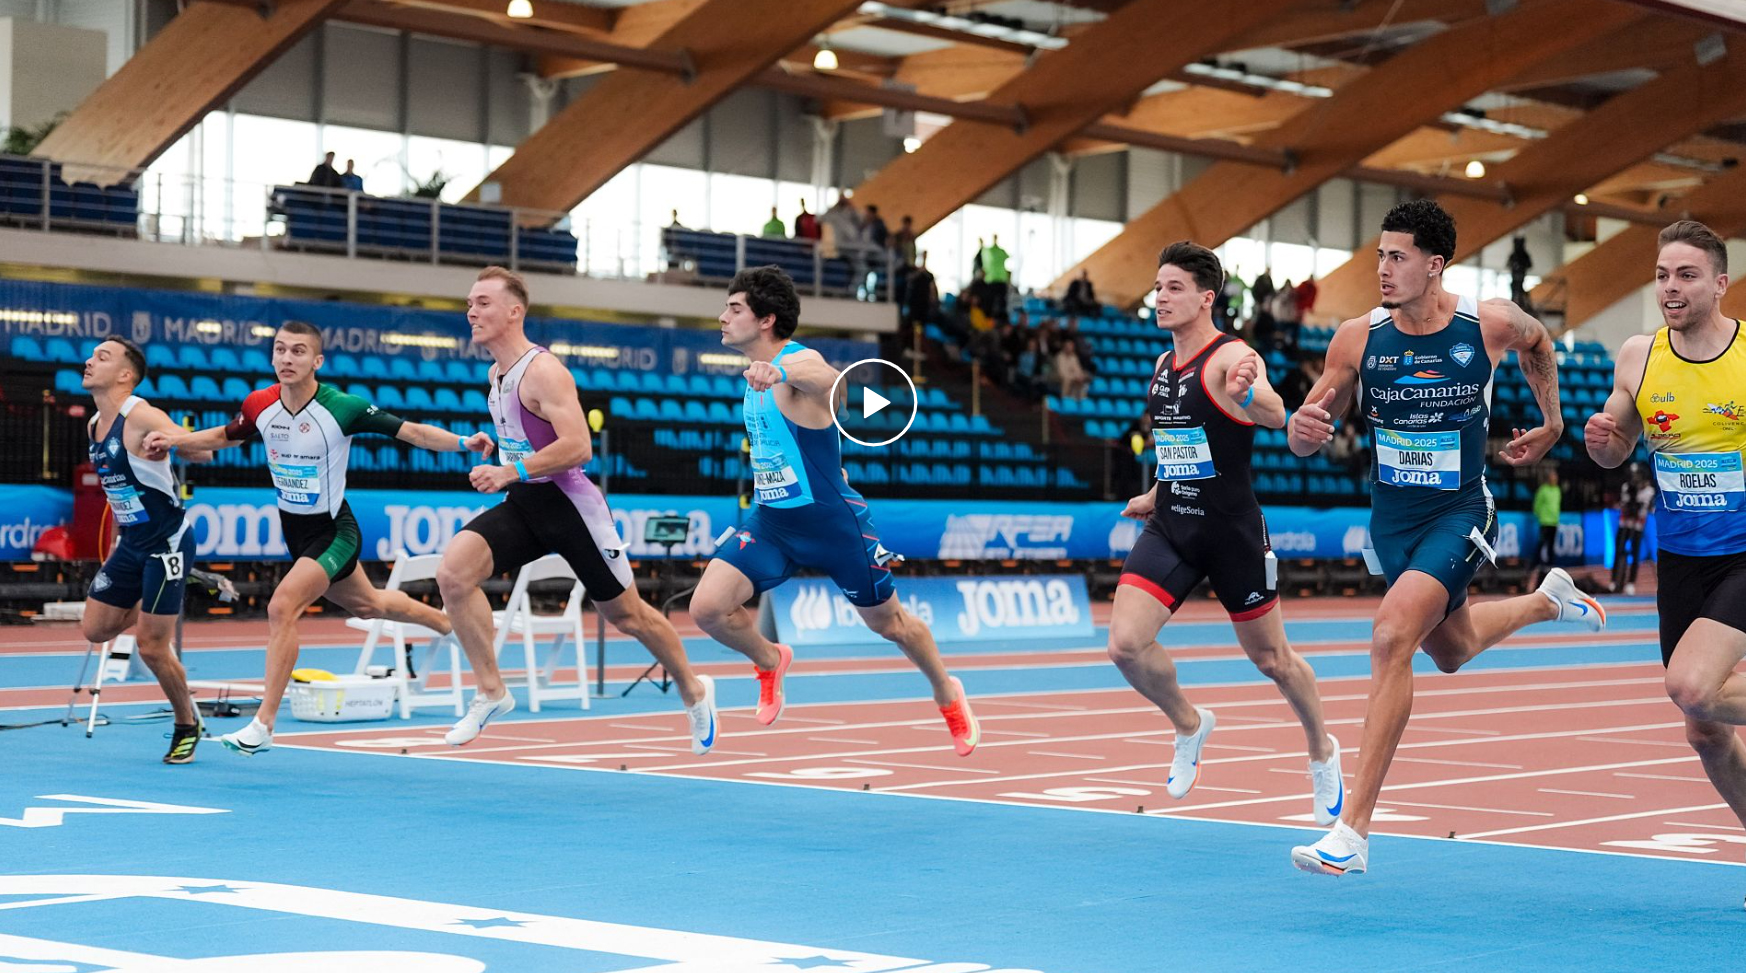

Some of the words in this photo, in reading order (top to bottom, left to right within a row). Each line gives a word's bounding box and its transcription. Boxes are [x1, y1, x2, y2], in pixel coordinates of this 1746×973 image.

[1379, 356, 1399, 364] DXT
[1370, 382, 1479, 404] CajaCanarias
[1420, 396, 1477, 408] FUNDACIÓN
[1175, 434, 1190, 442] 2025
[1378, 433, 1413, 447] MADRID
[1414, 438, 1437, 447] 2025
[1160, 446, 1172, 460] SAN
[1173, 446, 1198, 460] PASTOR
[1398, 450, 1433, 467] DARIAS
[1163, 464, 1200, 478] Joma
[1658, 459, 1694, 469] MADRID
[1695, 459, 1718, 469] 2025
[1391, 469, 1442, 486] Joma
[1679, 473, 1717, 488] ROELAS
[1675, 493, 1728, 507] Joma
[169, 556, 181, 576] 8
[957, 579, 1080, 637] Joma
